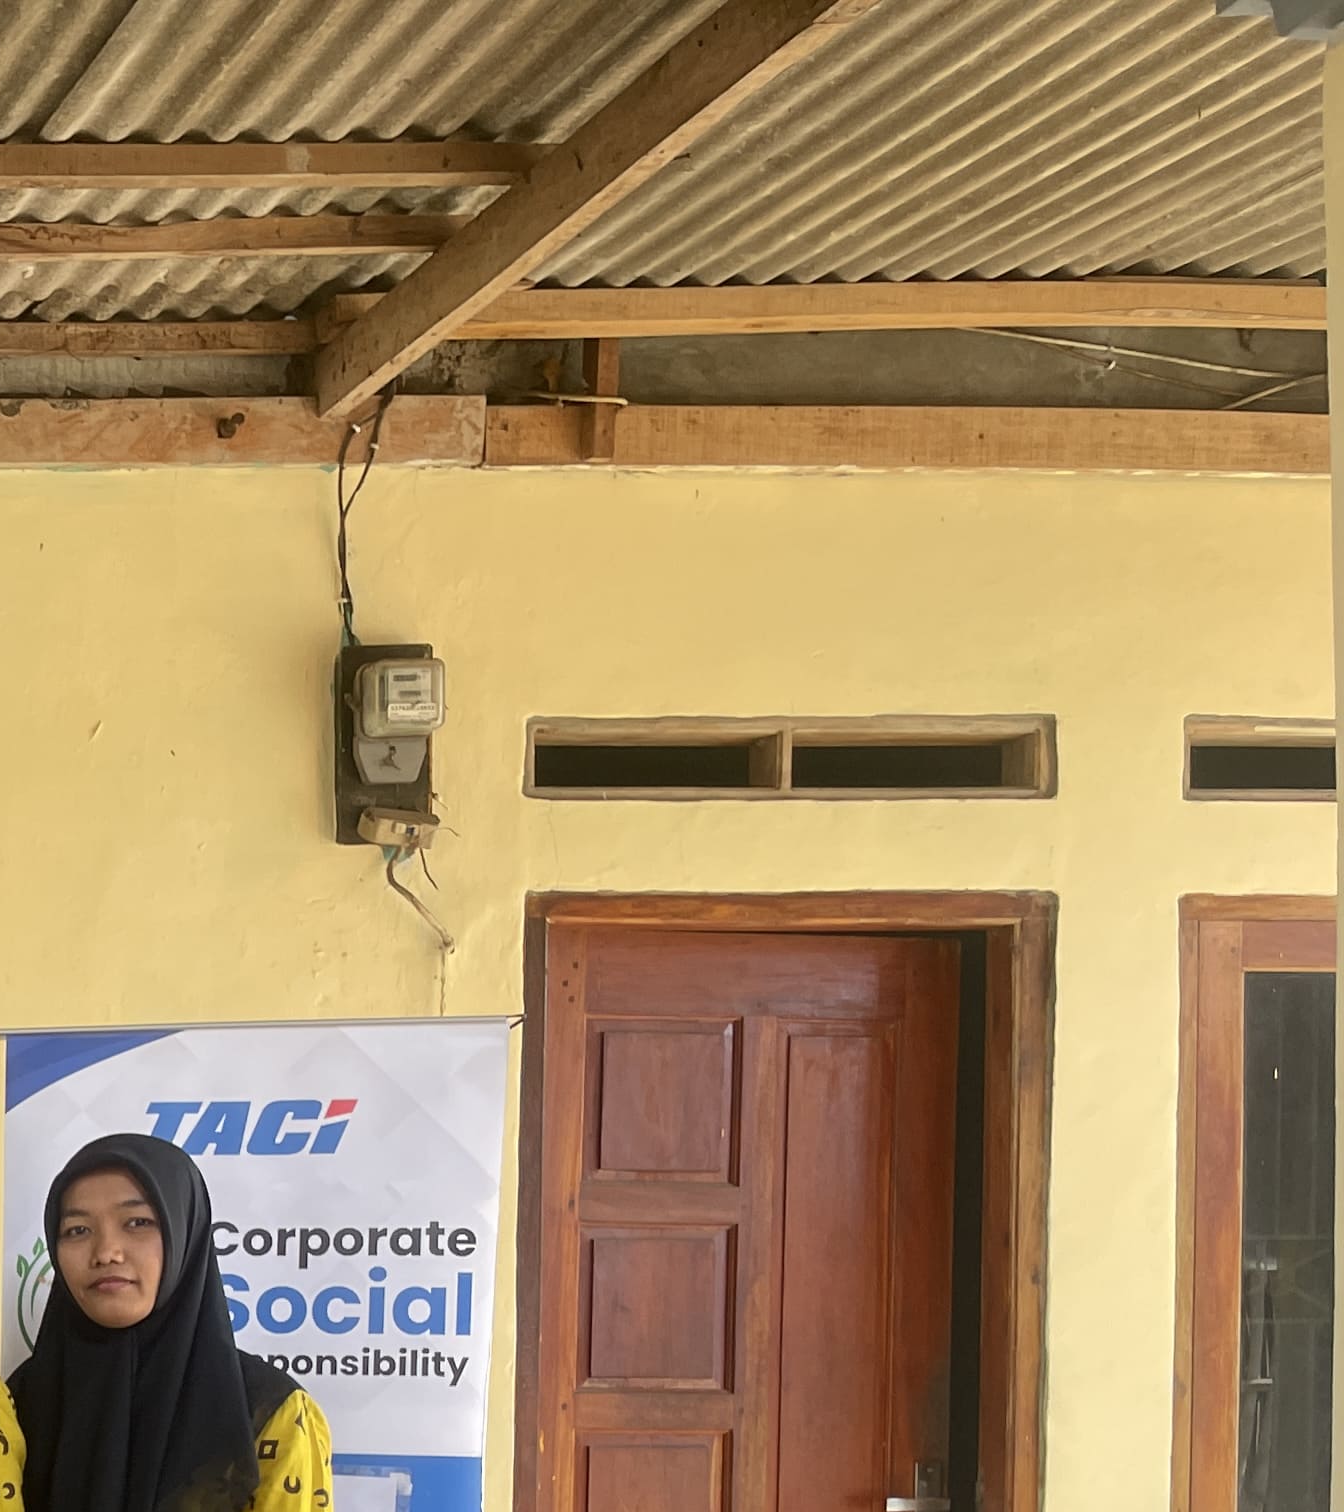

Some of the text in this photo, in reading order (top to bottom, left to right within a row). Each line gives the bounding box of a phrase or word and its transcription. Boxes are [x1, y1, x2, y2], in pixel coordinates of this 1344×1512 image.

[212, 1221, 477, 1270] Corporate
[219, 1266, 474, 1336] Social
[264, 1347, 469, 1387] ponsibility
